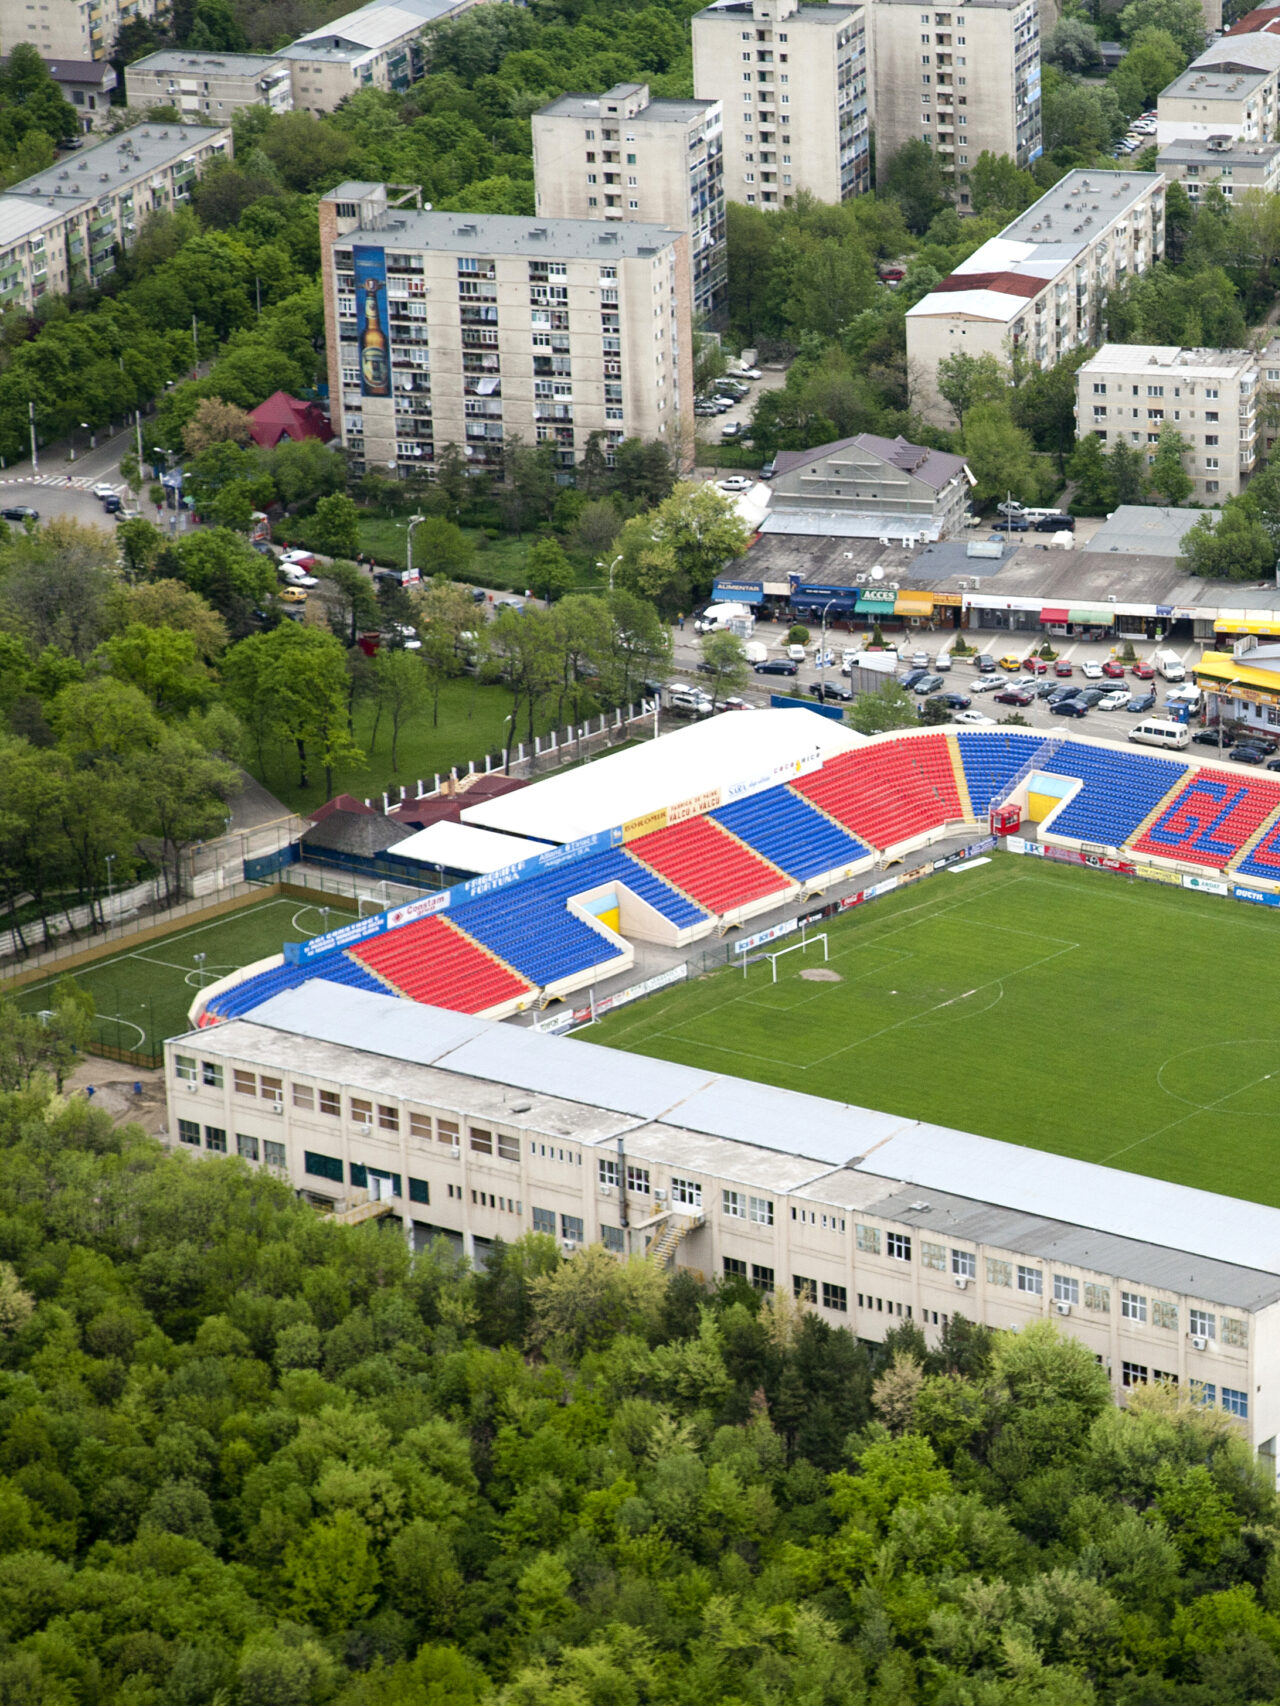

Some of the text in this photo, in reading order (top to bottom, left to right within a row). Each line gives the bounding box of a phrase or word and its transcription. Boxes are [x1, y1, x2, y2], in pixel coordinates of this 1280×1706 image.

[863, 590, 895, 600] ACCES
[624, 811, 666, 832] BOROMIR
[1024, 842, 1043, 855] UPC
[471, 872, 520, 897] FORTUNA
[1236, 889, 1264, 901] DUCTIL
